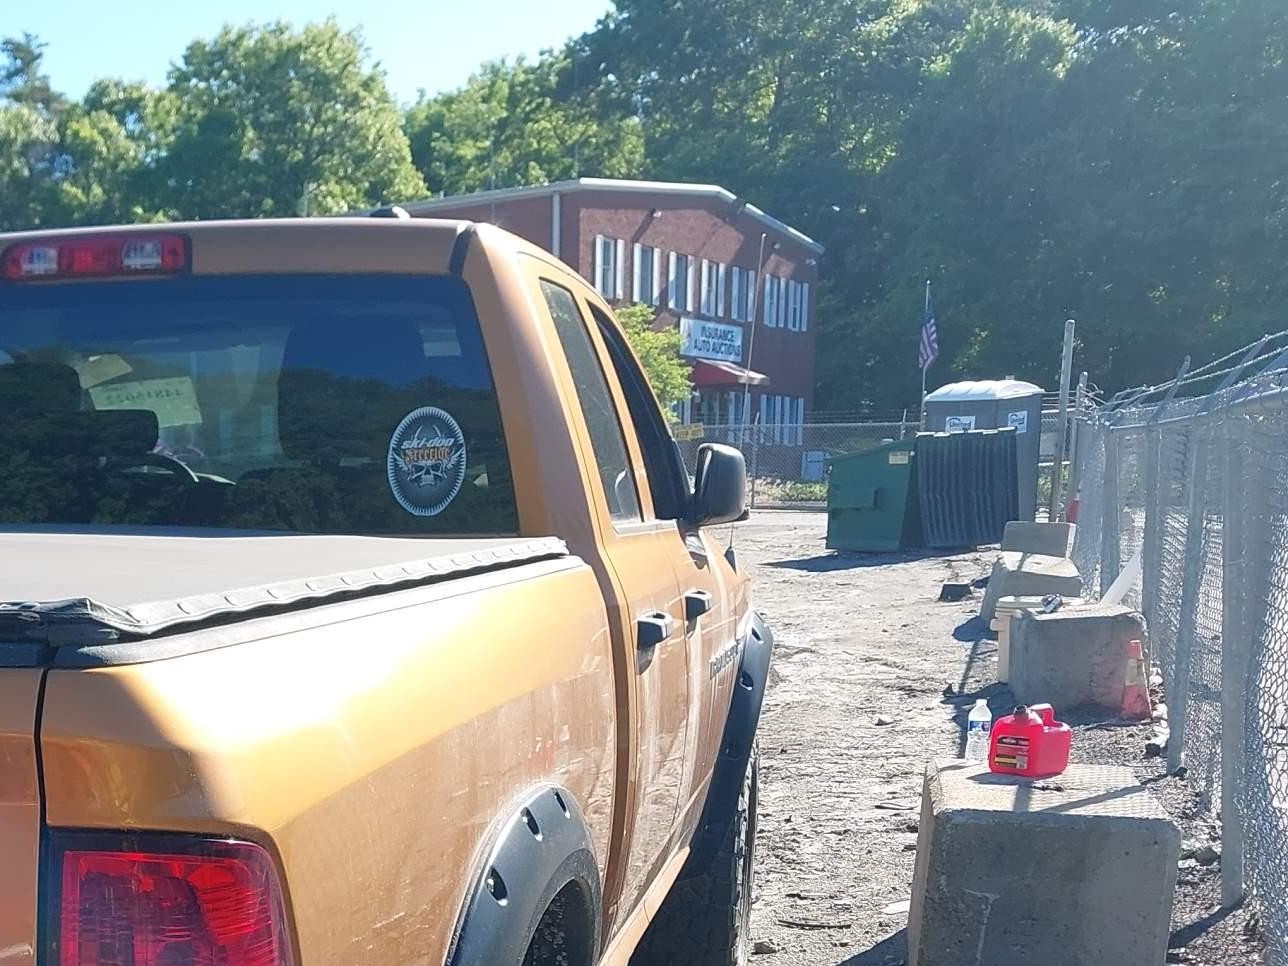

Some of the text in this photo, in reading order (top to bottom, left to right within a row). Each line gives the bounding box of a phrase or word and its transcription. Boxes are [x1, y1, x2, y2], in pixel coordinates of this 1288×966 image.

[701, 325, 735, 343] INSURANCE
[693, 338, 741, 357] AUTO AUCTIONS
